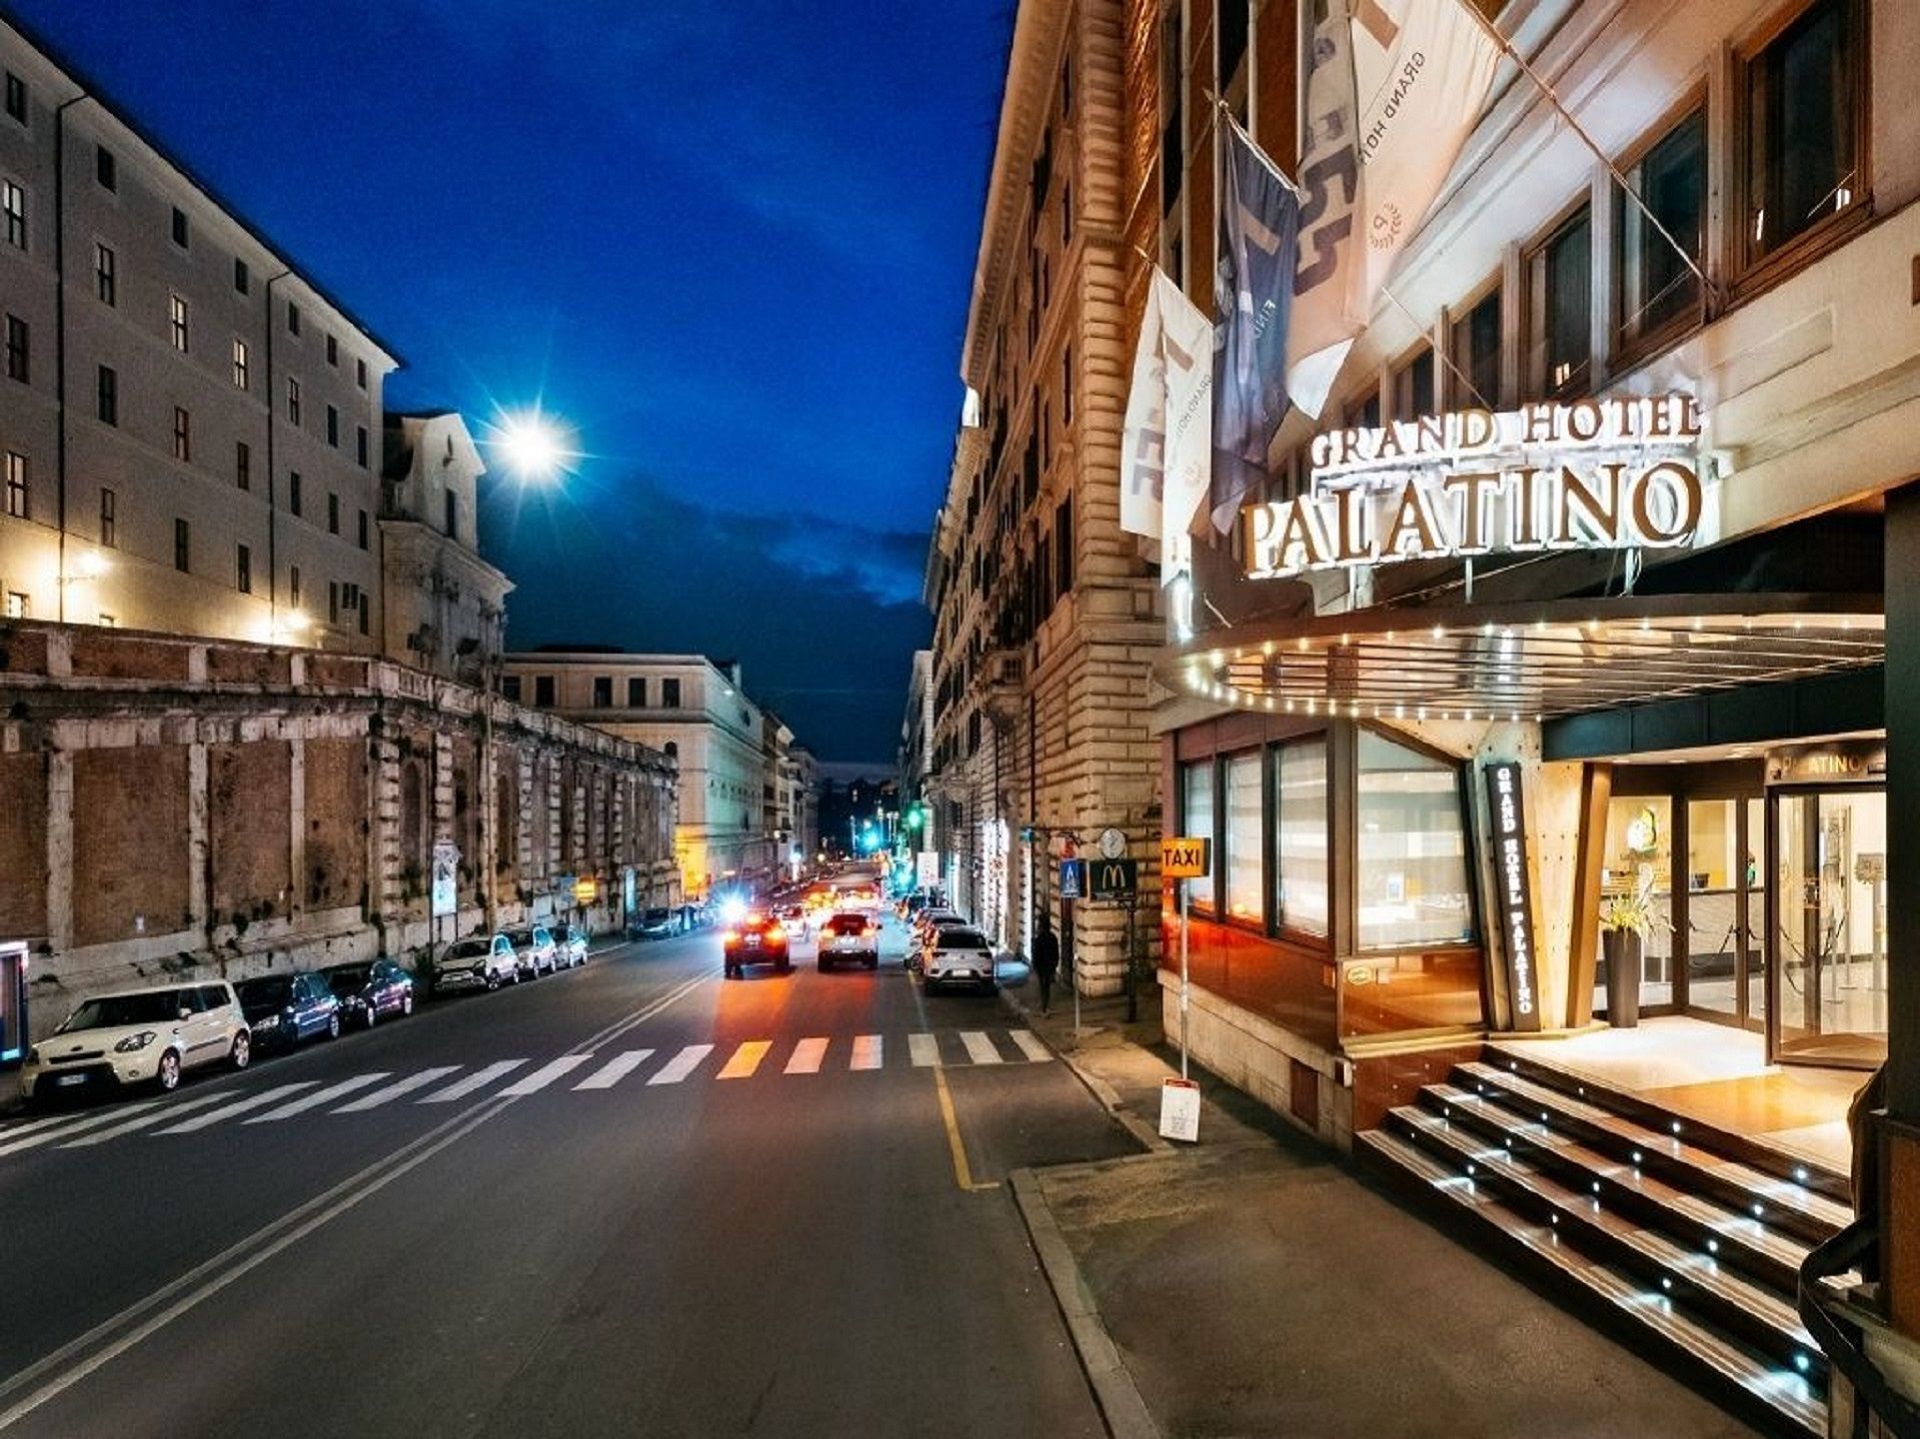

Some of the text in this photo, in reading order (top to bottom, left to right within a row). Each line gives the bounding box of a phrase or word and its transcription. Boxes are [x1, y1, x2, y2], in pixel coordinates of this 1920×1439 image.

[1311, 395, 1702, 466] GRAND HOTEL
[1242, 461, 1703, 577] PALATINO
[1164, 849, 1200, 867] TAXI
[1496, 767, 1533, 1015] GRAND HOTEL PALATINO
